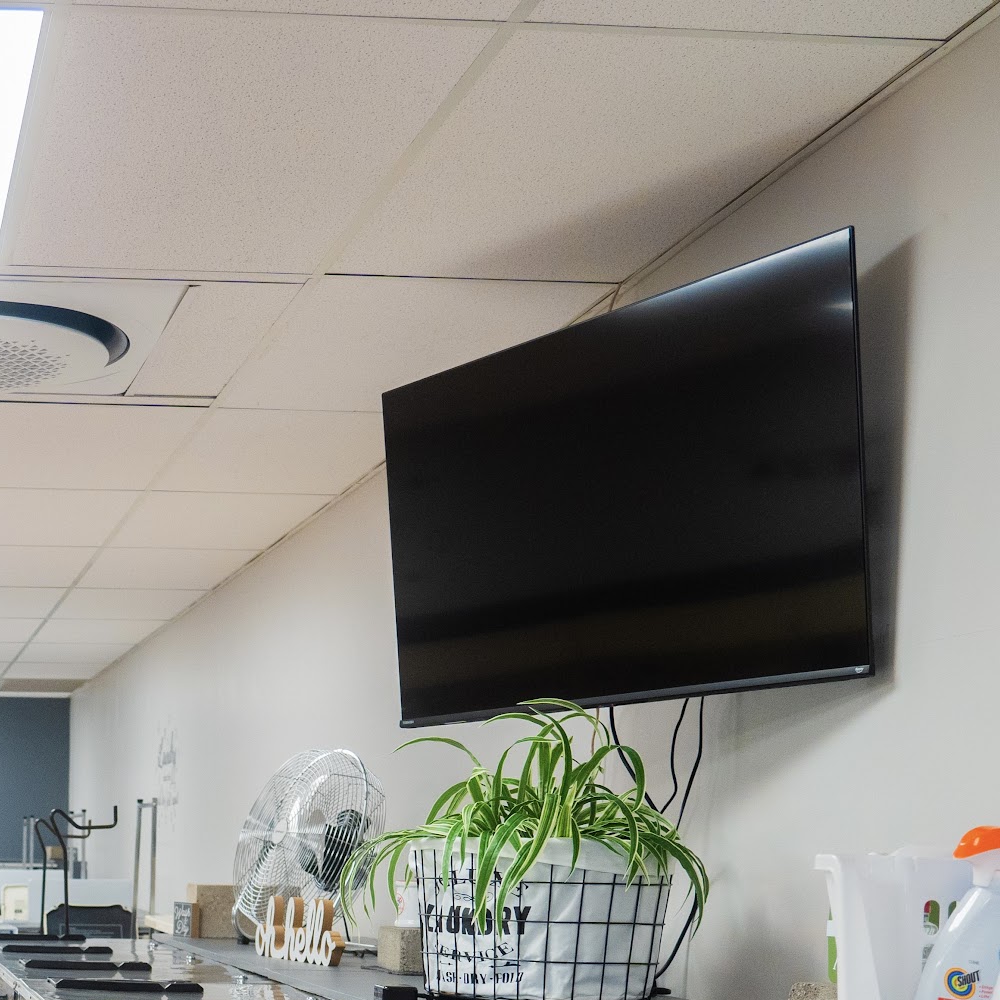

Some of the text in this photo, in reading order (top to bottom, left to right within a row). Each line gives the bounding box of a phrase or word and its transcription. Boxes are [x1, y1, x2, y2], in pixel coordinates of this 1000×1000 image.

[255, 896, 336, 967] oh hello
[434, 942, 514, 962] ERVICE
[957, 969, 980, 987] SHOUT
